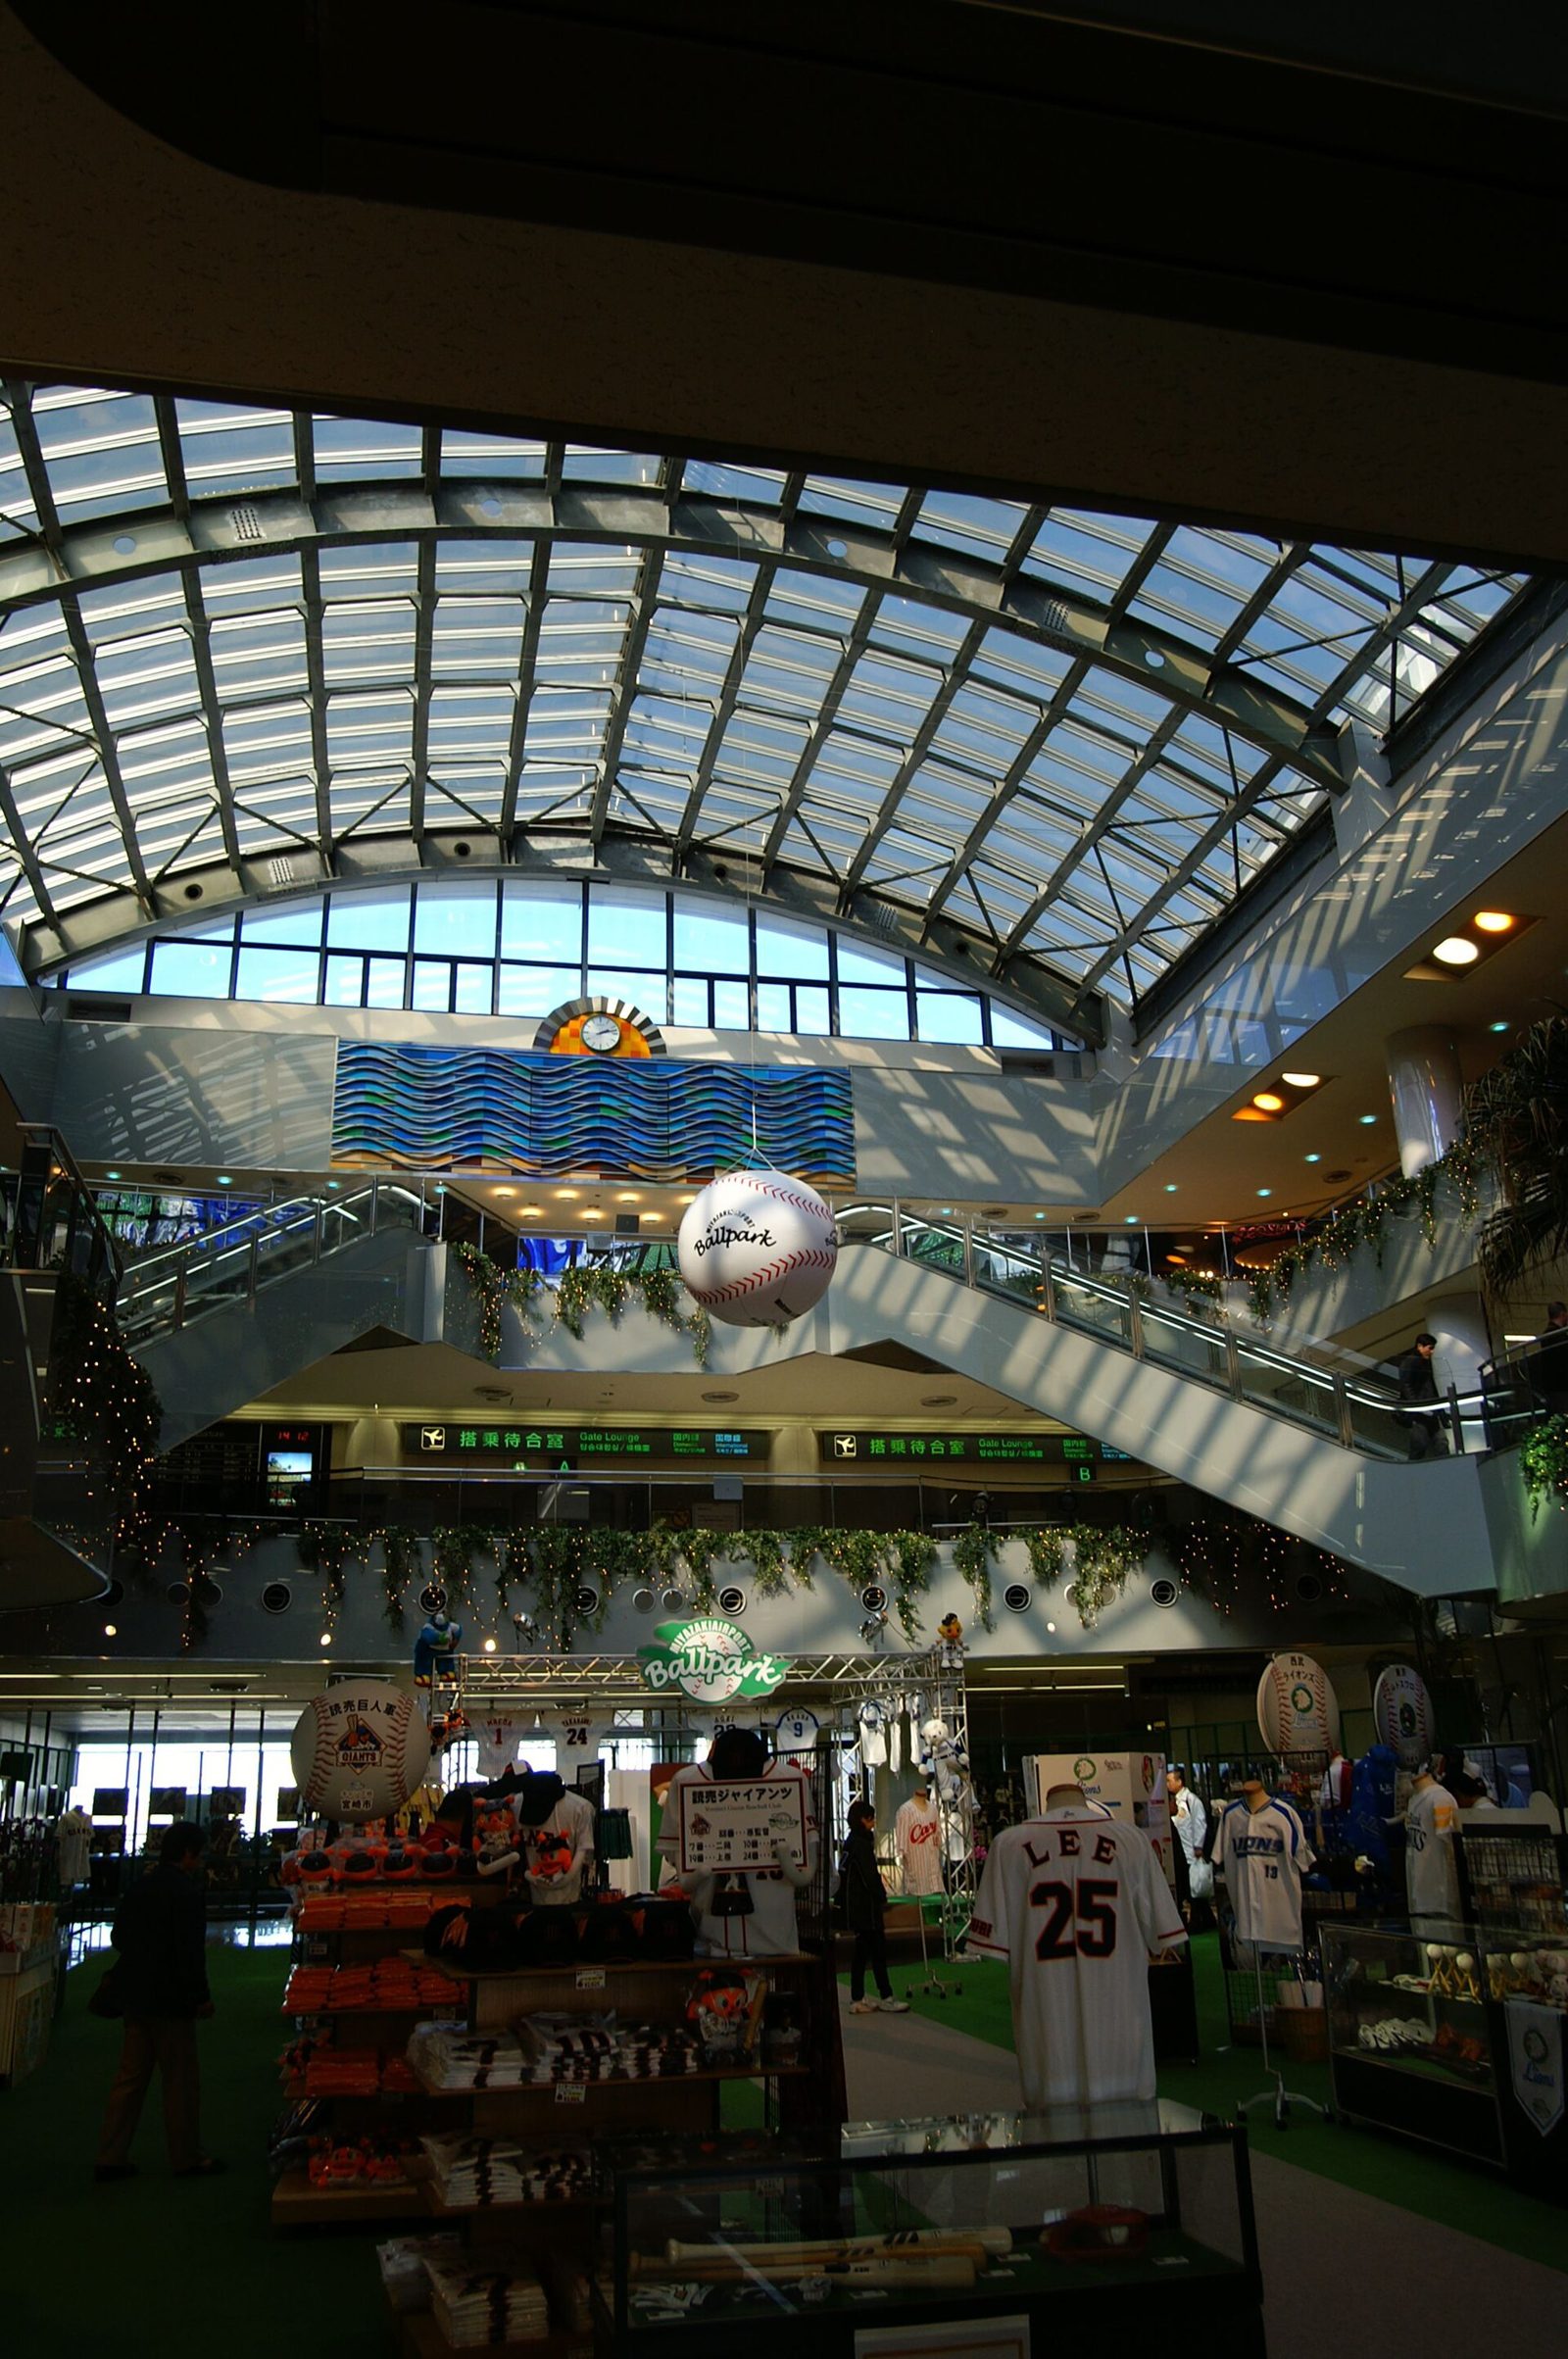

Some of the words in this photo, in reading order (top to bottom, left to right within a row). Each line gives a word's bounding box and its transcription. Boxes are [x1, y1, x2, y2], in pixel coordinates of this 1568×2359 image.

[694, 1225, 777, 1256] Ballpark
[460, 1431, 564, 1449] 搭乗待合室
[579, 1432, 603, 1442] Gate
[869, 1438, 966, 1455] 搭乗待合室
[1079, 1467, 1091, 1481] B
[645, 1646, 782, 1688] Ballpark
[328, 1698, 397, 1716] 読売巨人軍
[495, 1727, 503, 1745] 1
[567, 1727, 587, 1745] 24
[794, 1722, 803, 1738] 9
[342, 1751, 377, 1762] GIANTS
[692, 1787, 792, 1804] 読売ジャイアンツ
[1022, 1829, 1117, 1868] LEE
[1031, 1878, 1118, 1961] 25
